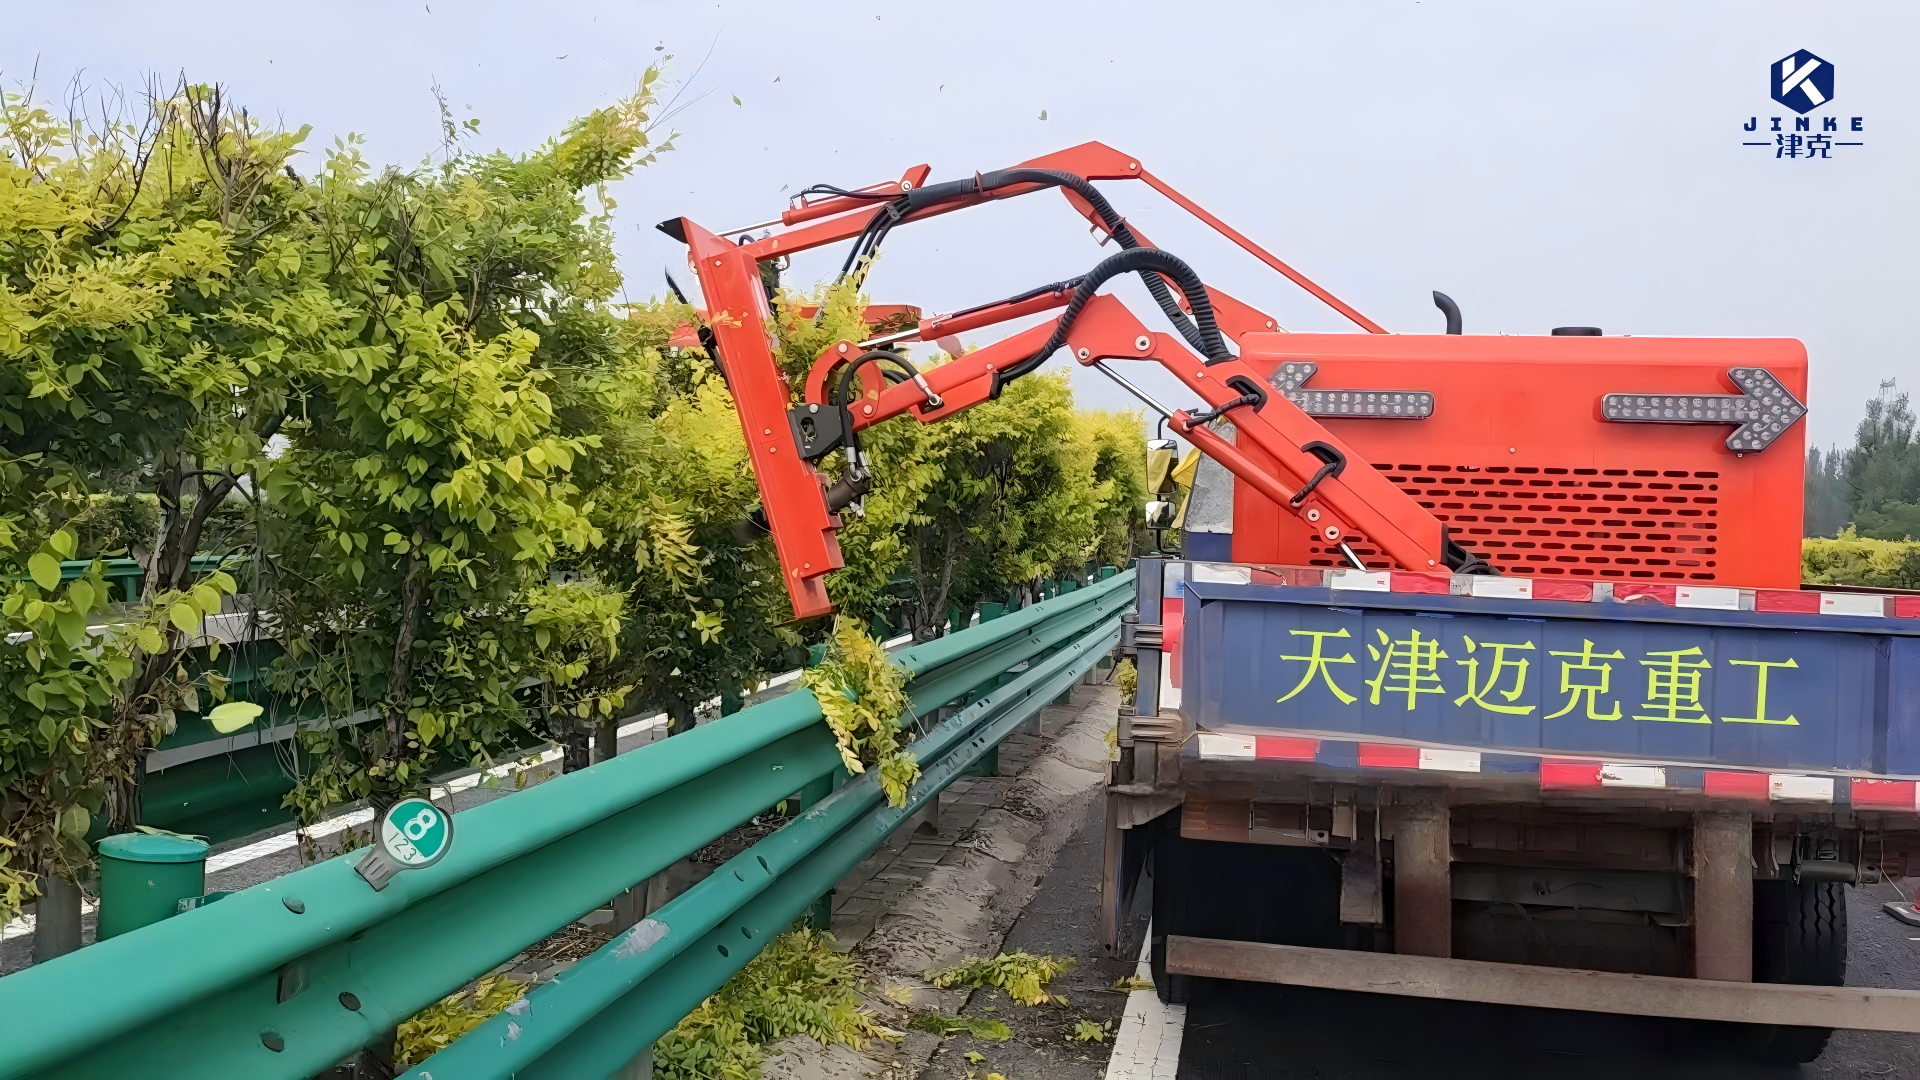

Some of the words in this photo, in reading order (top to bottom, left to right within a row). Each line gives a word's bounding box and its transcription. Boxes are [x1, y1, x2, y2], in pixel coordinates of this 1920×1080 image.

[1277, 627, 1800, 726] 天津迈克重工
[404, 808, 437, 841] 8
[388, 832, 417, 861] 123
